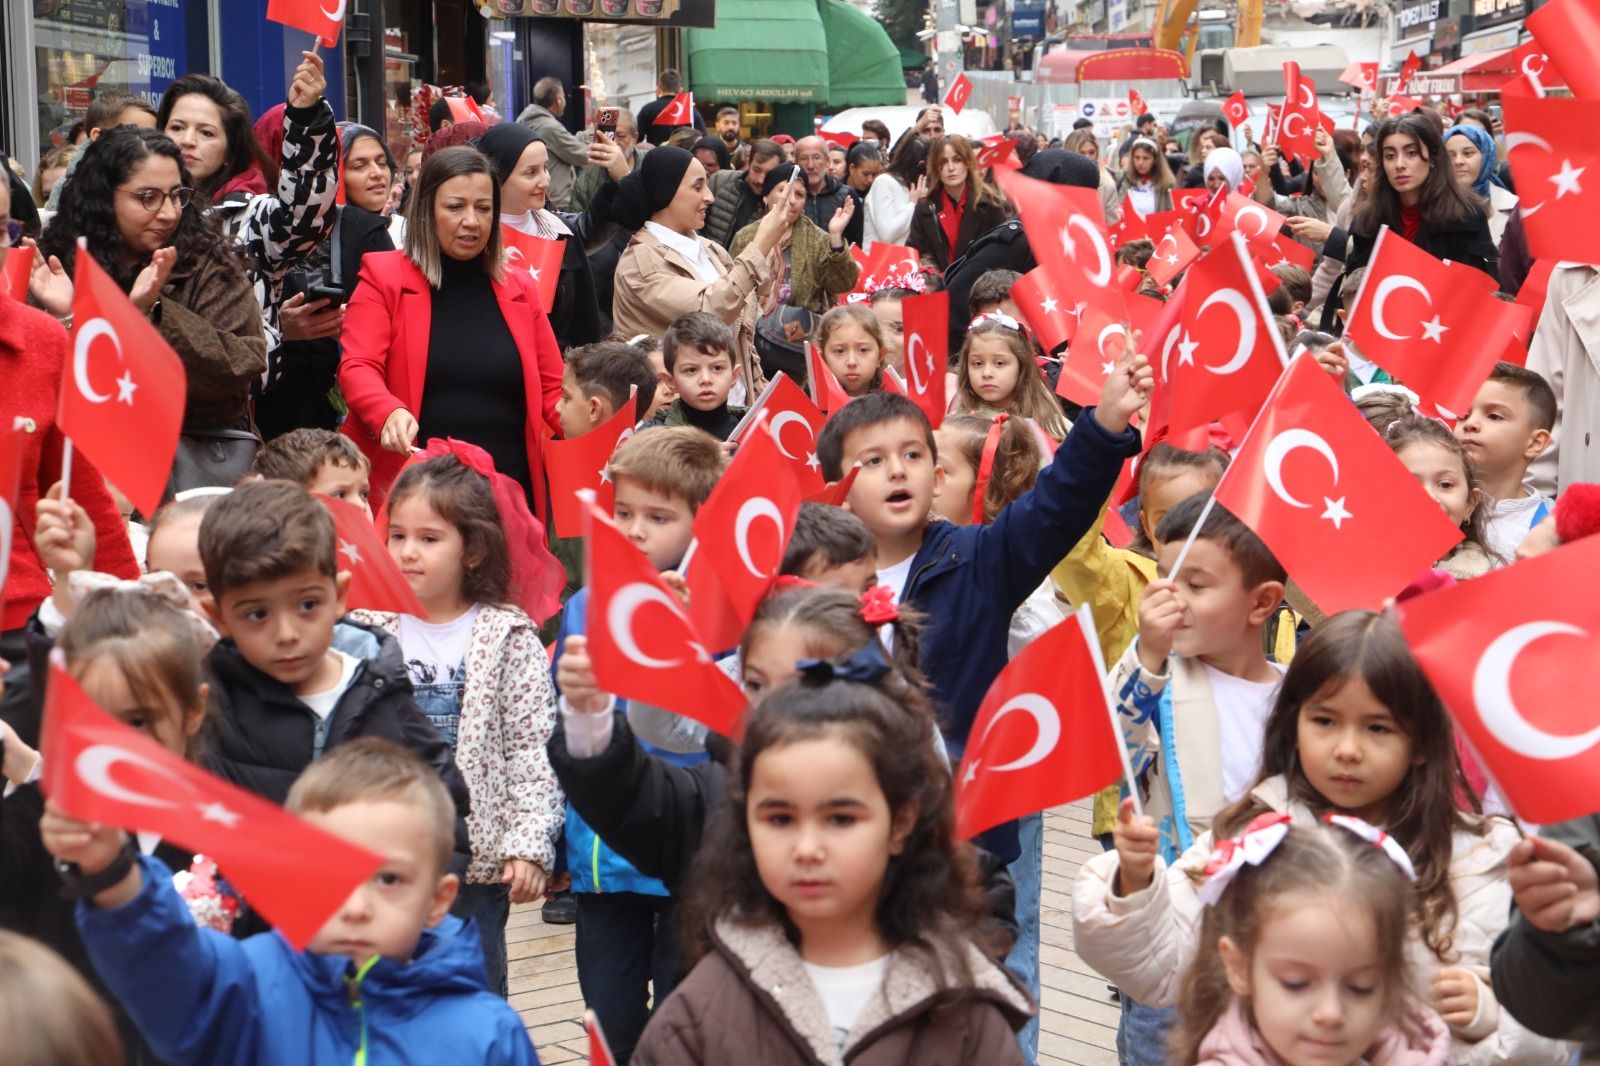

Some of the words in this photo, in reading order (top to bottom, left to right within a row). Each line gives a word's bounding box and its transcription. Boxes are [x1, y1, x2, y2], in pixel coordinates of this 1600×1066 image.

[153, 19, 160, 40] &
[138, 53, 176, 79] SUPERBOX
[717, 88, 754, 97] HELVACI
[754, 88, 799, 97] ABDULLAH
